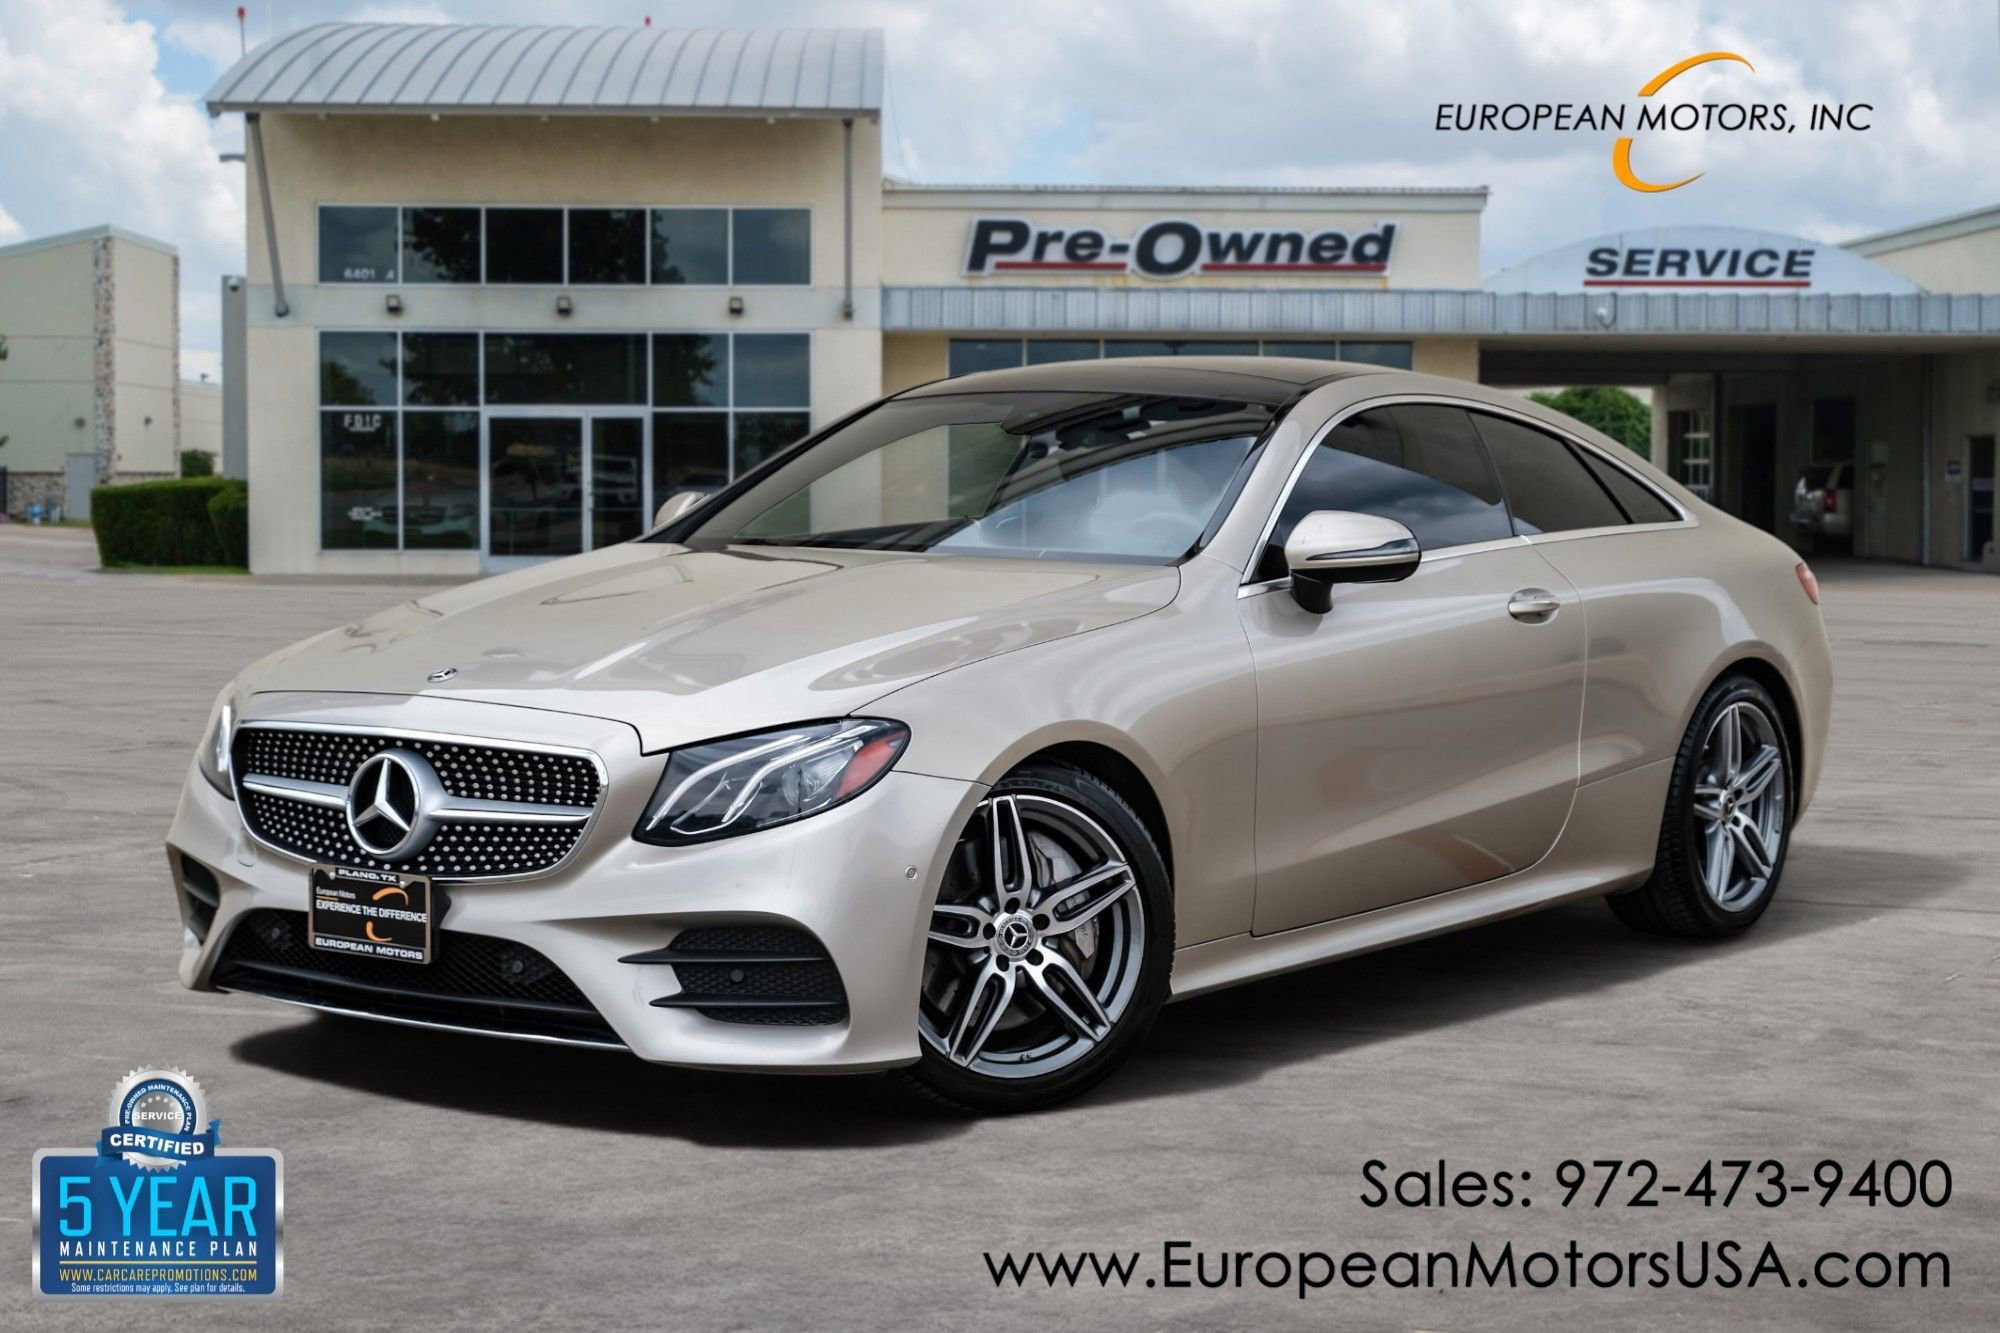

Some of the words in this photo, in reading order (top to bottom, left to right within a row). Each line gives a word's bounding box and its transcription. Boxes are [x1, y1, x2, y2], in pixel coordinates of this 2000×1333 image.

[965, 218, 1398, 277] Pre-Owned
[1584, 248, 1815, 279] SERVICE
[380, 874, 397, 882] TX
[316, 900, 362, 915] EXPERIENCE
[362, 905, 378, 917] THE
[378, 907, 428, 923] DIFFERENCE
[315, 938, 373, 953] EUROPEAN
[376, 946, 423, 960] MOTORS
